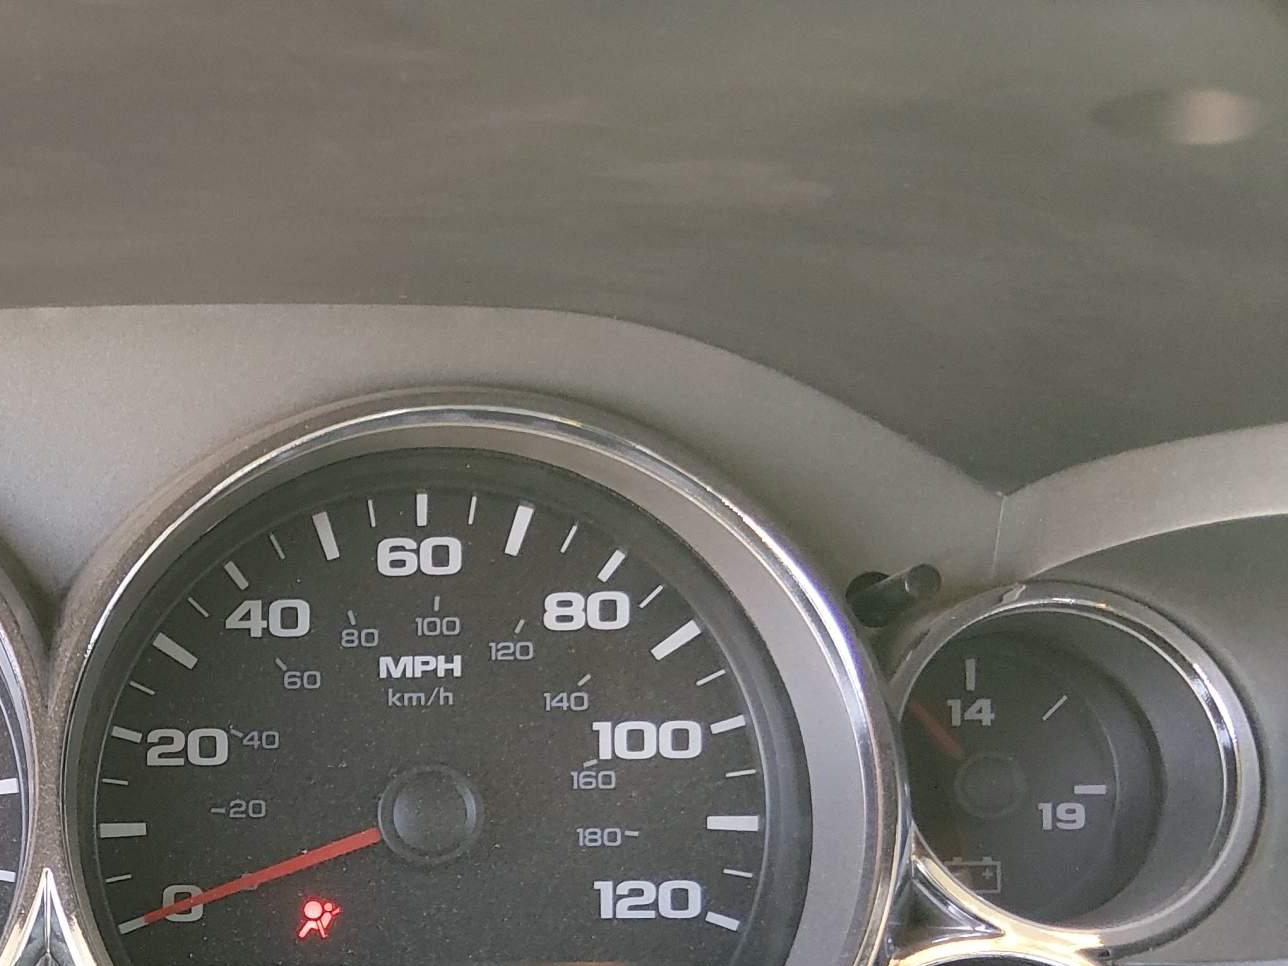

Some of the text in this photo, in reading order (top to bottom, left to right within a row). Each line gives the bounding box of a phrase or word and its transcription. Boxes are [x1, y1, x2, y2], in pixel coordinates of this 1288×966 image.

[377, 536, 462, 576] 60
[225, 599, 310, 638] 40
[543, 591, 630, 630] 80
[415, 616, 460, 636] 100
[340, 627, 379, 647] 80
[489, 641, 534, 661] 120
[379, 656, 462, 678] MPH
[283, 670, 321, 689] 60
[387, 687, 454, 707] km/h
[544, 692, 589, 711] 140
[947, 699, 995, 726] 14
[146, 727, 229, 766] 20
[241, 731, 279, 749] 40
[592, 721, 702, 759] 100
[572, 771, 616, 790] 160
[229, 800, 266, 818] 20
[1039, 802, 1086, 830] 19
[577, 828, 621, 846] 180
[162, 885, 204, 922] 0
[593, 880, 702, 918] 120
